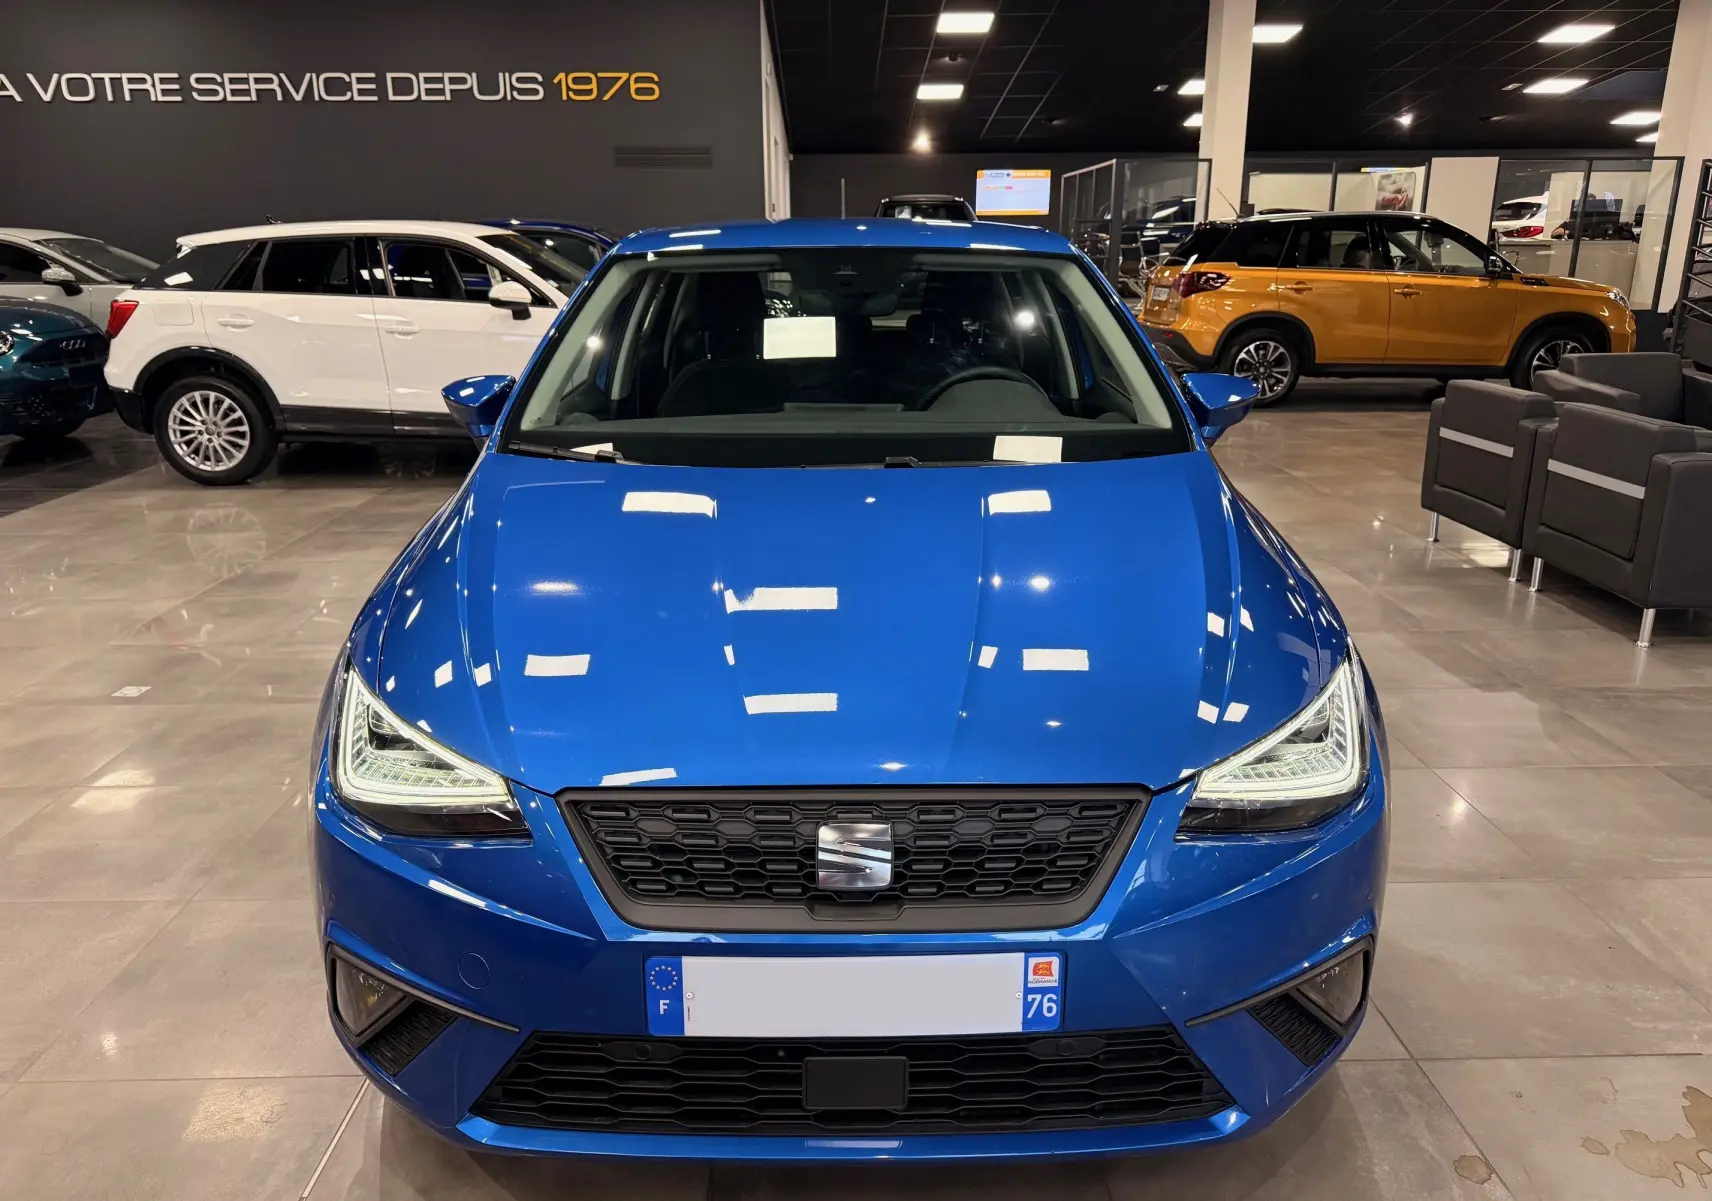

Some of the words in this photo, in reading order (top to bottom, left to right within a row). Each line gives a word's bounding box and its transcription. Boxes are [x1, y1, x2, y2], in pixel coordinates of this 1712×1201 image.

[26, 72, 183, 102] VOTRE
[189, 72, 379, 101] SERVICE
[386, 71, 545, 101] DEPUIS
[552, 71, 660, 101] 1976
[659, 999, 670, 1015] F
[1026, 993, 1058, 1019] 76
